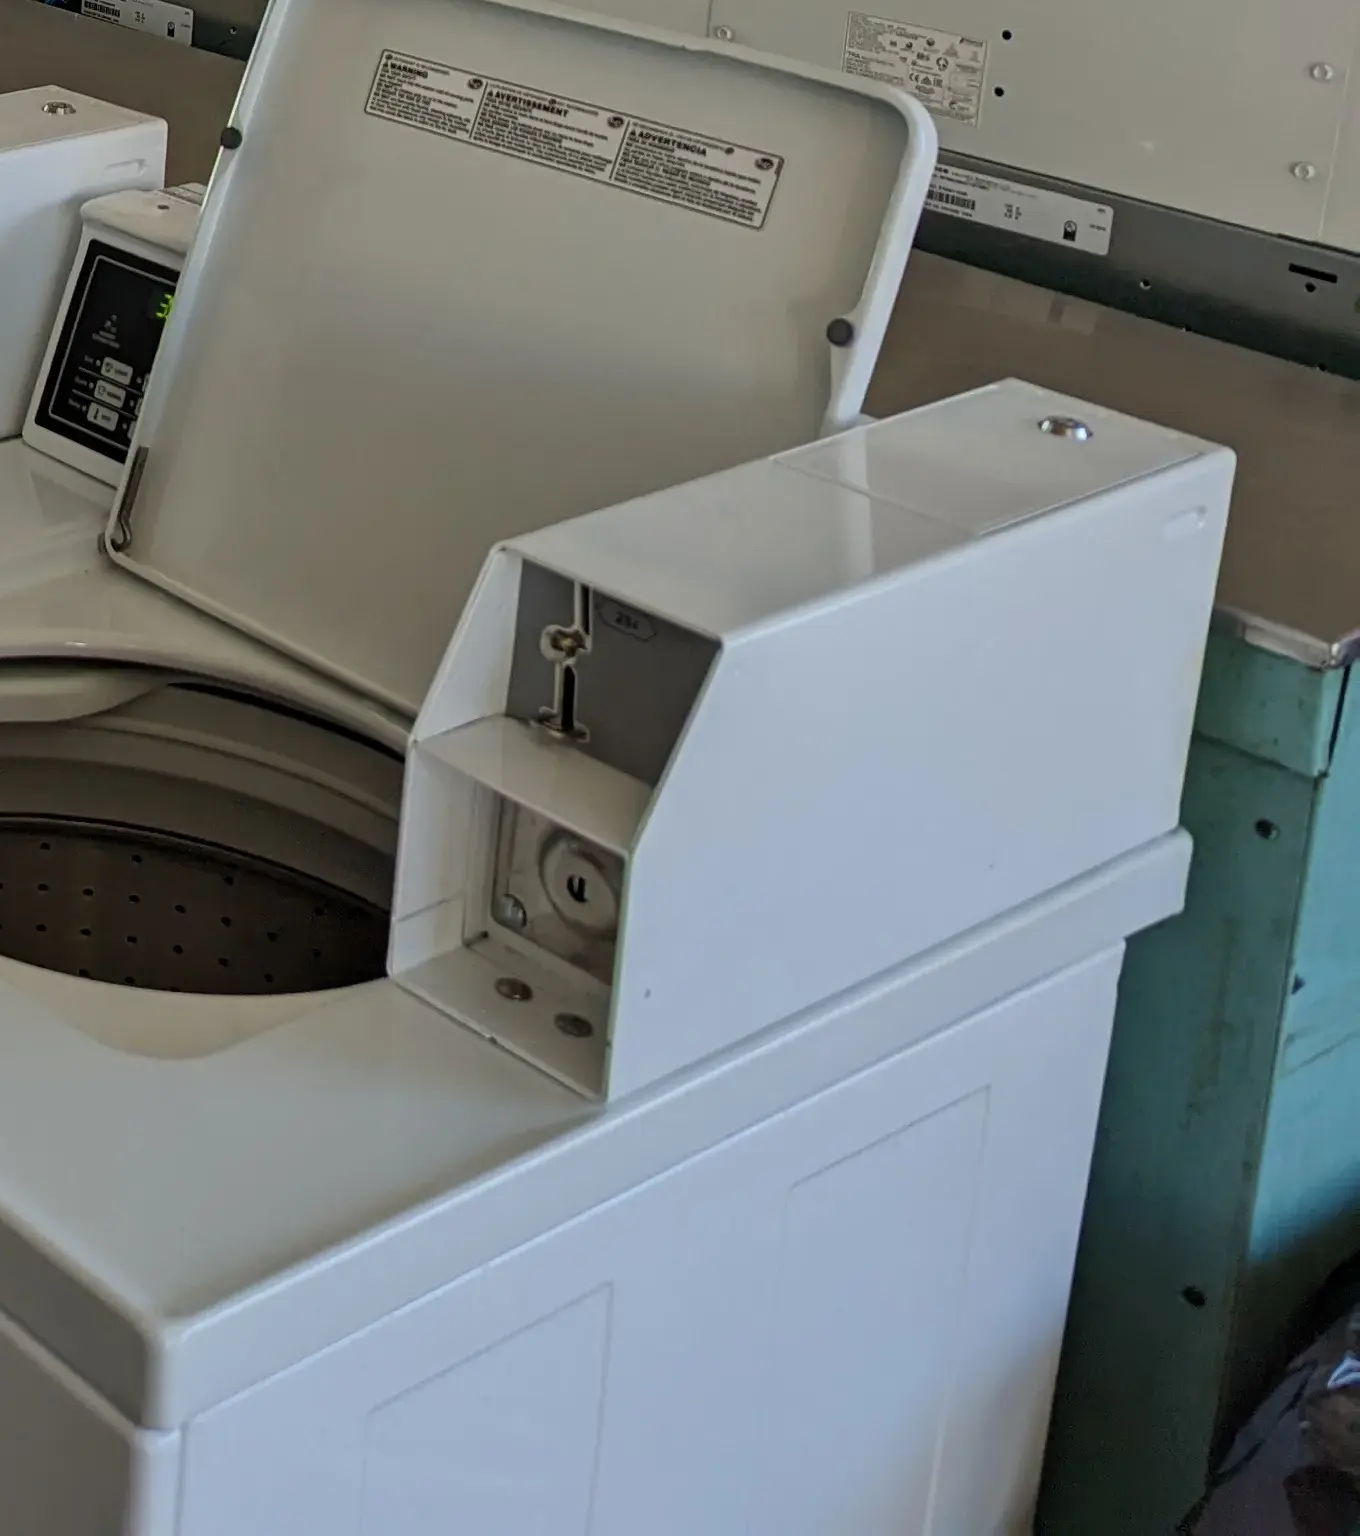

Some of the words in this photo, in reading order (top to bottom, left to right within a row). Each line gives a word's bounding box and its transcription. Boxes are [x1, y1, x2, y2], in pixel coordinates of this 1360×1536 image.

[390, 62, 429, 79] WARNING
[495, 90, 569, 118] AVERTISSEMENT
[638, 132, 707, 157] ADVERTENCIA
